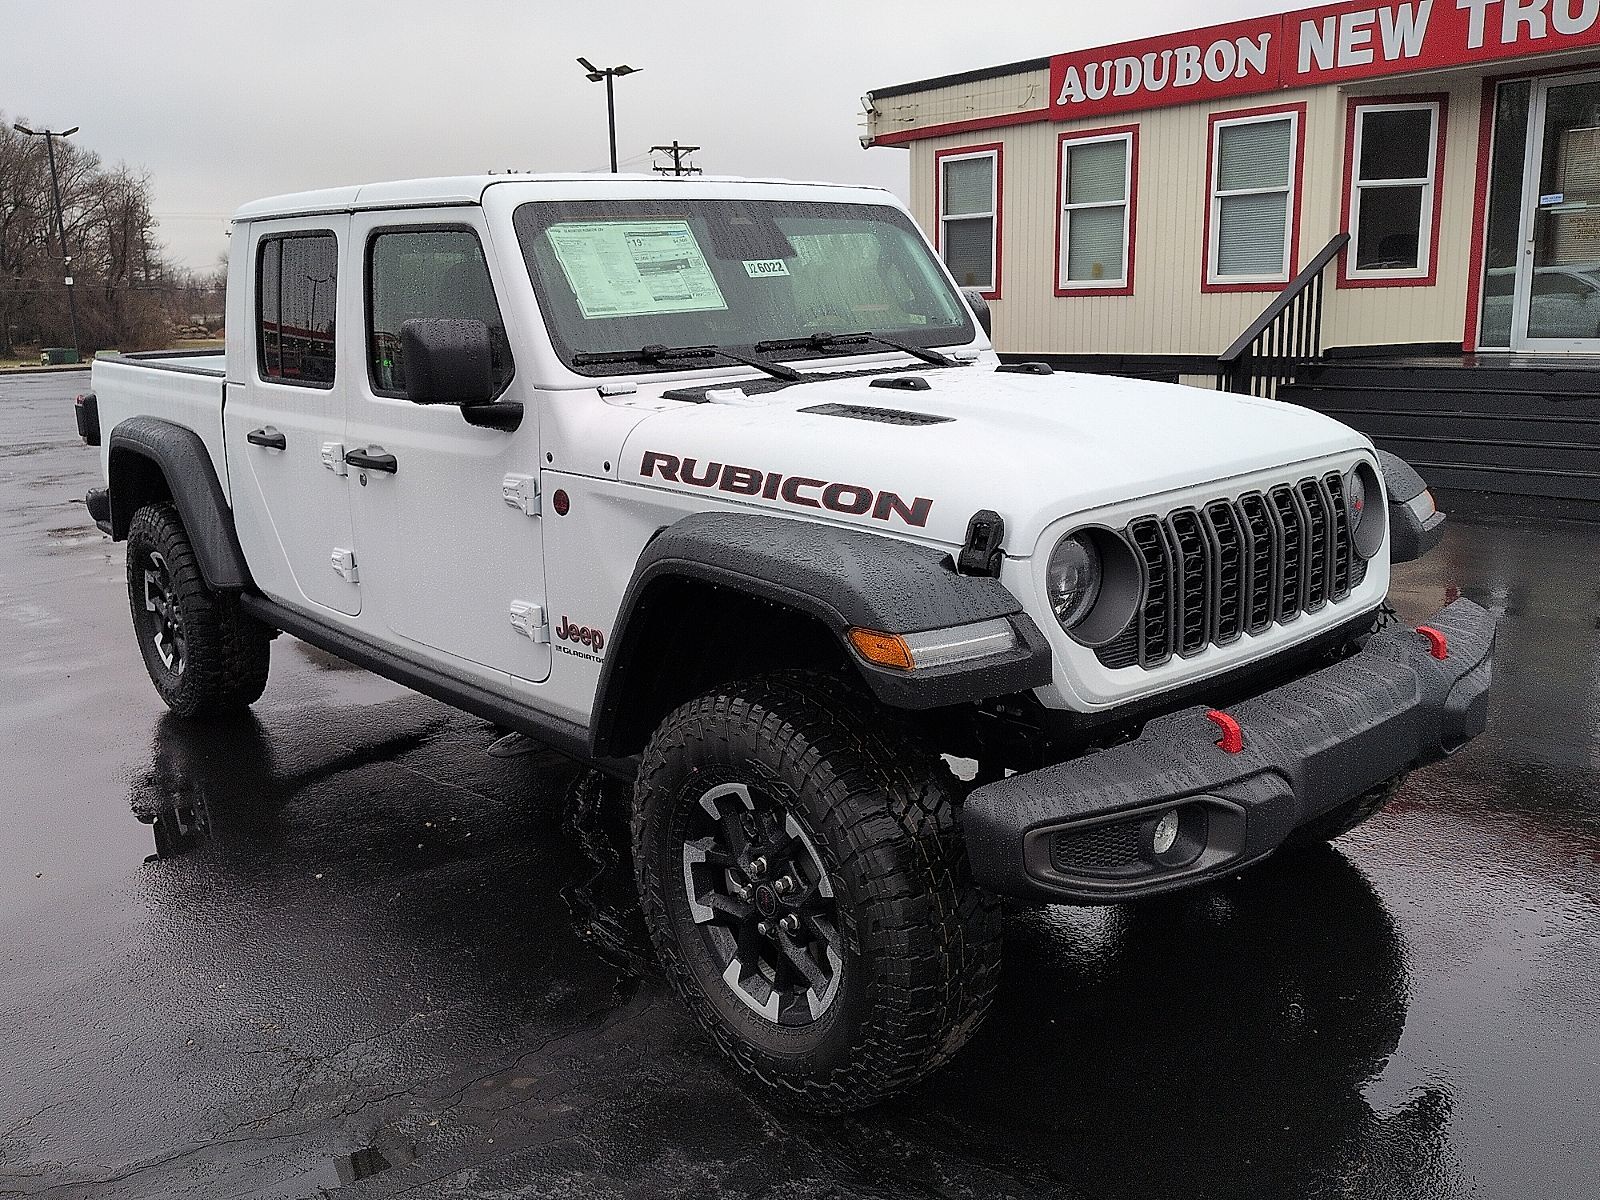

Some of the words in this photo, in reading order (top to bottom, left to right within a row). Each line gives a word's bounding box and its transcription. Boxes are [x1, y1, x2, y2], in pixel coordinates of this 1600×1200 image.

[1056, 33, 1271, 105] AUDUBON
[1297, 0, 1434, 73] NEW
[757, 262, 785, 273] 6022
[639, 450, 934, 528] RUBICON
[555, 615, 605, 654] Jeep
